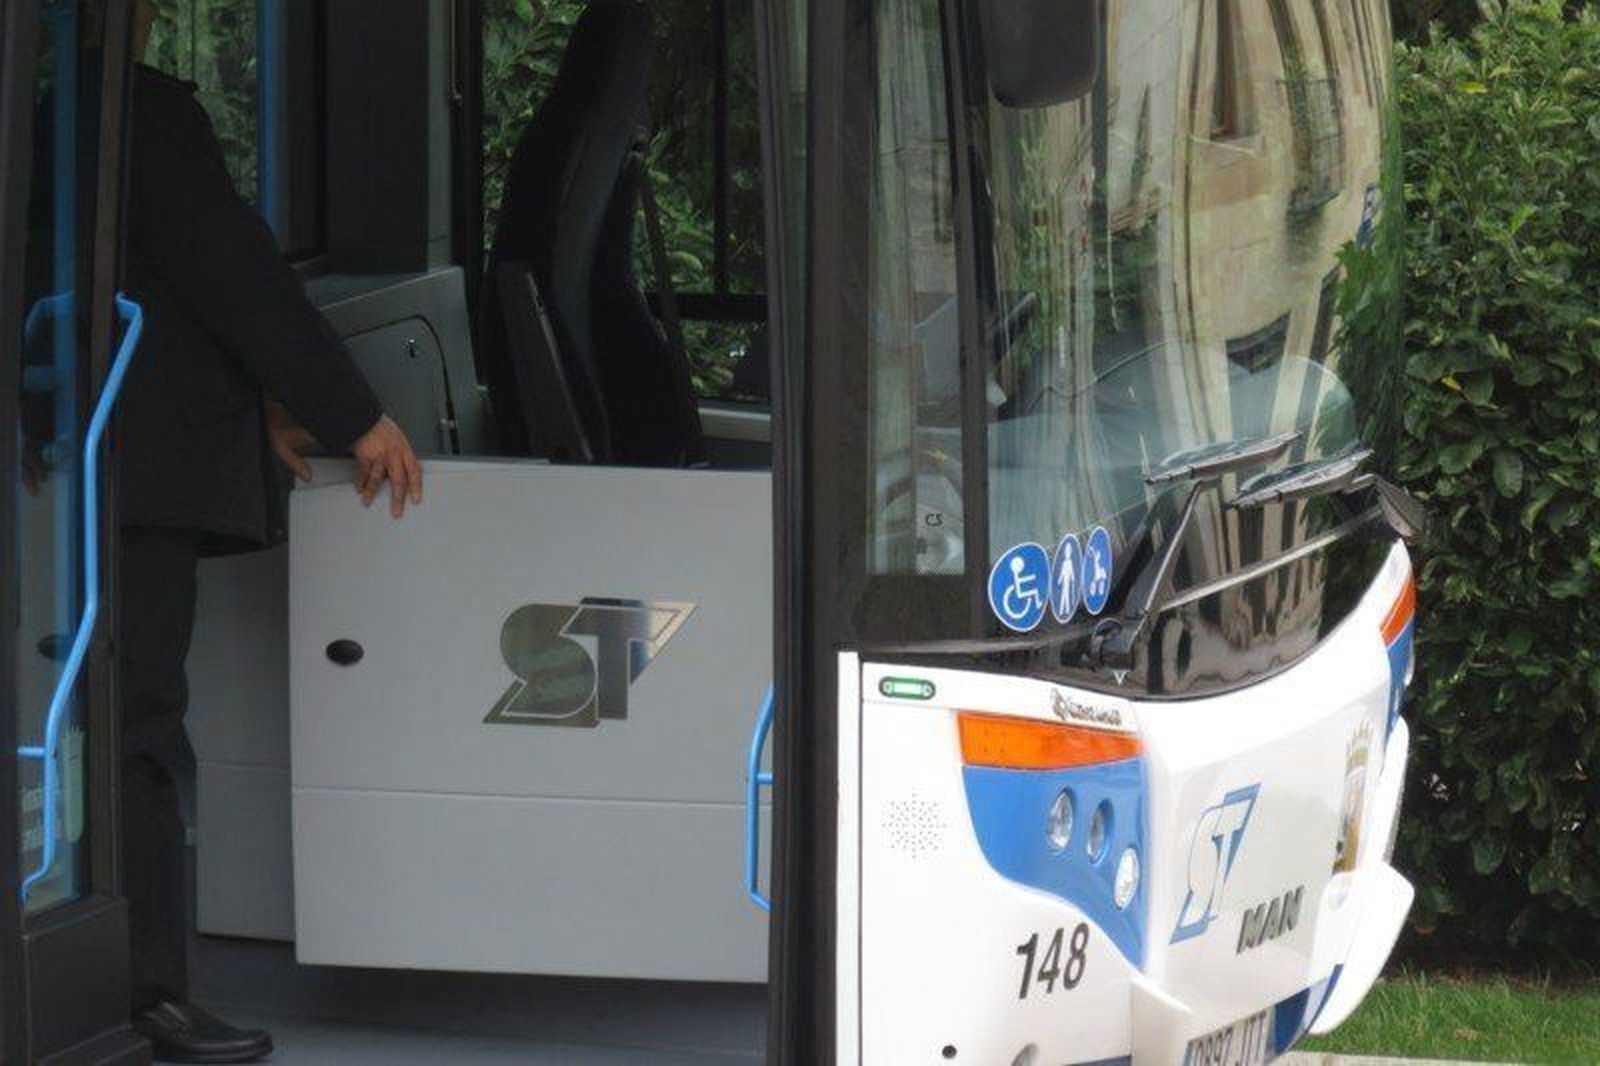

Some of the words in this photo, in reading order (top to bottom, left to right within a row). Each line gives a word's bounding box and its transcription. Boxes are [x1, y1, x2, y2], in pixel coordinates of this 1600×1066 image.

[482, 596, 697, 729] ST
[1236, 884, 1304, 955] MAN
[1016, 922, 1090, 1000] 148
